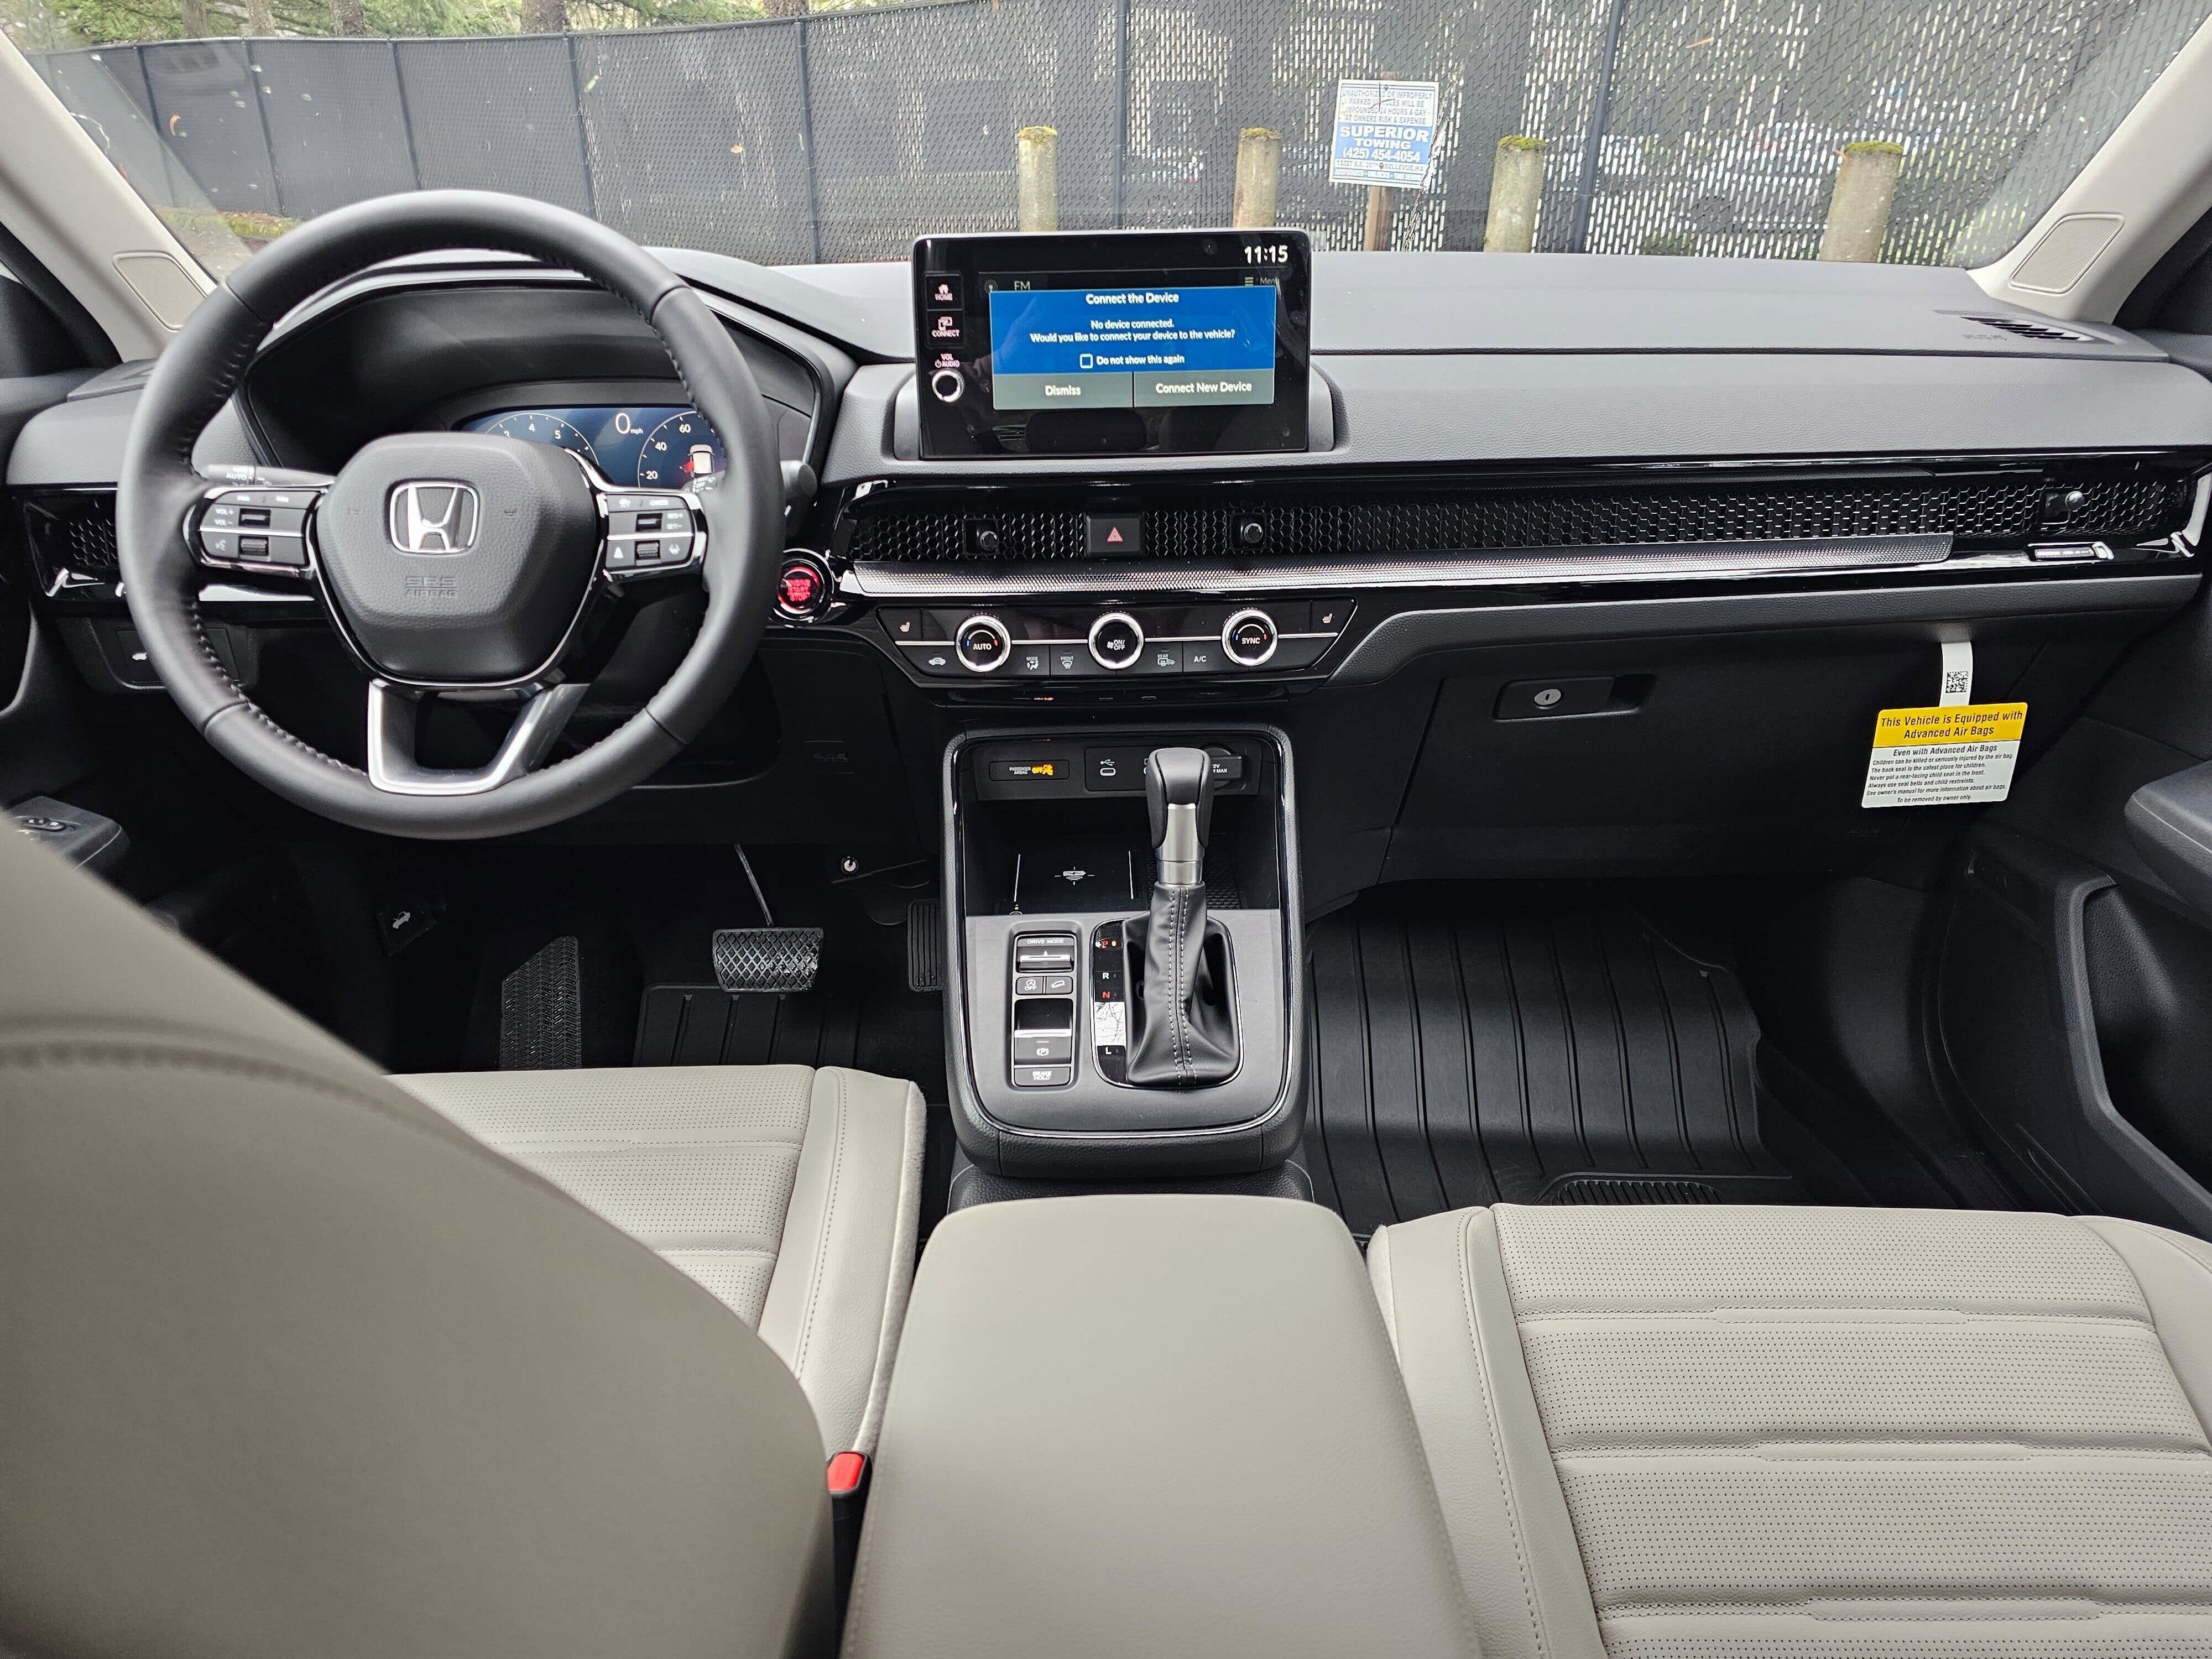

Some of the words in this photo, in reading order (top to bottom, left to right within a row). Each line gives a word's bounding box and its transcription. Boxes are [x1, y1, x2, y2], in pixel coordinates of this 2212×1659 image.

[1342, 89, 1385, 98] UNAUTHORIZD
[1397, 91, 1432, 100] IMPROPERLY
[1345, 106, 1378, 114] IMPOUNDED
[1339, 125, 1430, 142] SUPERIOR
[1354, 138, 1412, 150] TOWING
[1343, 147, 1370, 159] (425)
[1371, 150, 1421, 163] 454-4054
[1244, 245, 1288, 264] 11:15
[1014, 281, 1030, 291] FM
[1086, 294, 1126, 305] Connect
[1128, 293, 1144, 304] the
[1146, 293, 1180, 303] Device
[1091, 320, 1104, 329] No
[1105, 320, 1130, 329] device
[1131, 319, 1175, 328] connected.
[1030, 333, 1057, 343] Would
[1057, 335, 1074, 345] you
[1074, 332, 1089, 342] like
[1090, 333, 1099, 341] to
[1100, 332, 1132, 341] connect
[1133, 332, 1152, 342] your
[1152, 331, 1178, 340] device
[1190, 330, 1203, 339] the
[1204, 329, 1235, 338] vehicle?
[1097, 356, 1109, 364] Do
[1110, 356, 1124, 364] not
[1125, 356, 1146, 364] show
[1147, 354, 1162, 364] this
[1163, 354, 1185, 366] again
[1045, 385, 1081, 396] Dismiss
[1156, 383, 1194, 393] Connect
[1197, 383, 1218, 393] New
[1220, 382, 1252, 392] Device
[529, 424, 535, 432] 4
[615, 413, 631, 434] 0
[630, 427, 643, 435] mph
[679, 424, 691, 434] 60
[555, 430, 561, 439] 5
[655, 442, 667, 451] 40
[226, 472, 247, 481] AUTO
[646, 470, 658, 480] 20
[1881, 717, 1901, 727] This
[1905, 715, 1940, 726] Vehicle
[1943, 715, 1951, 724] is
[1954, 712, 1999, 725] Equipped
[2002, 711, 2023, 721] with
[1904, 728, 1950, 739] Advanced
[1954, 727, 1967, 736] Air
[1970, 726, 1994, 737] Bags
[1930, 745, 1965, 755] Advanced
[1980, 744, 1997, 753] Bags
